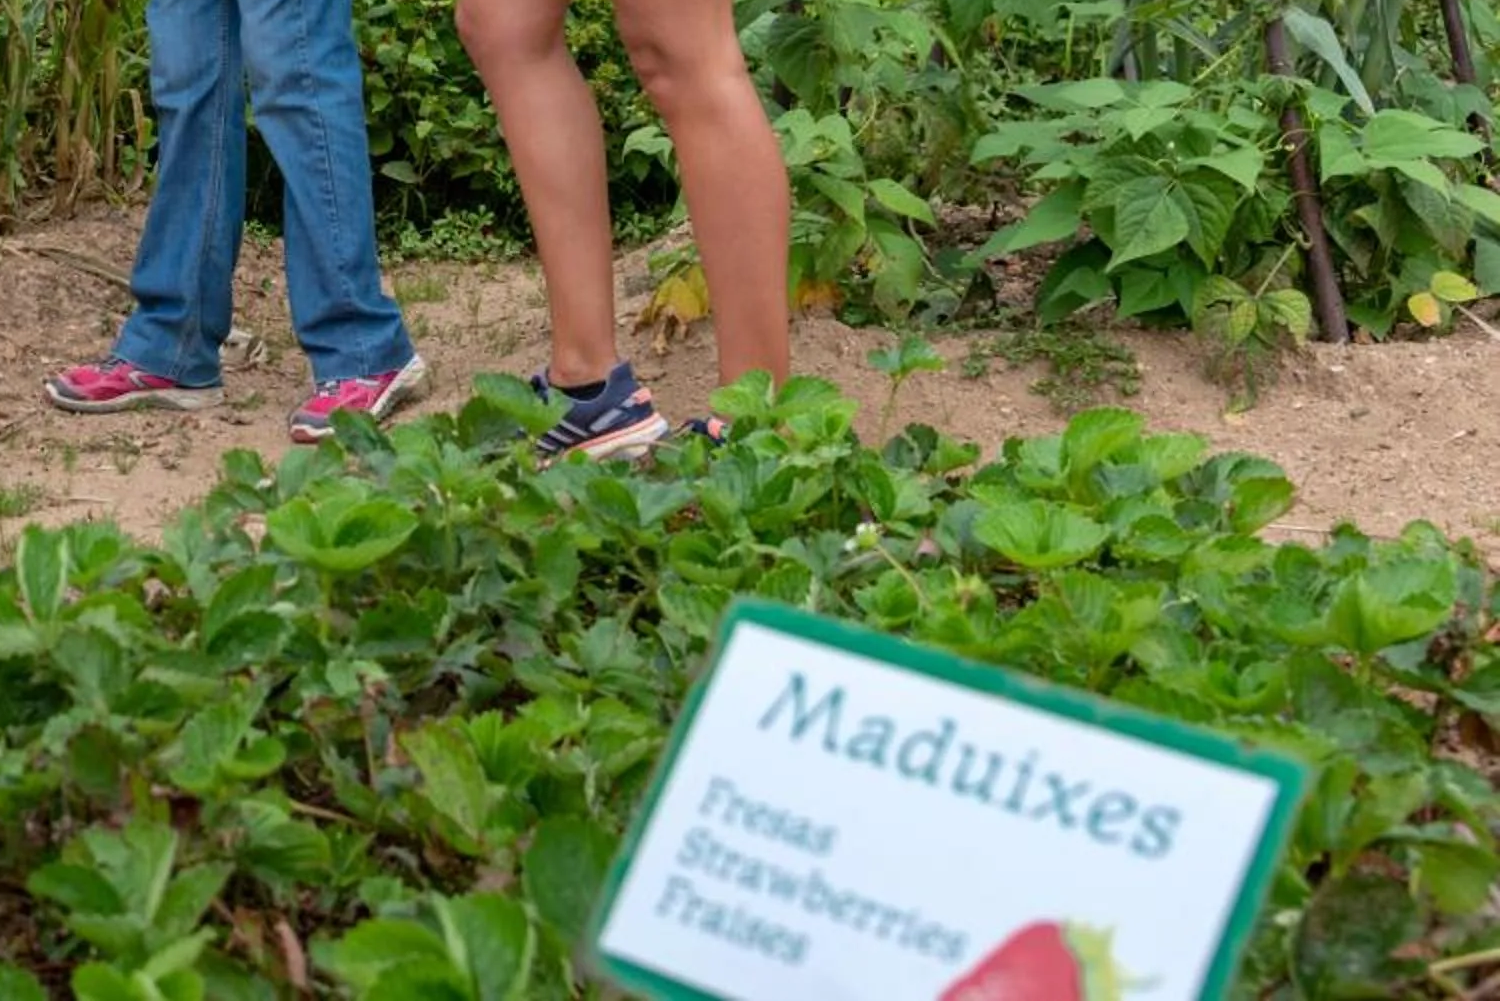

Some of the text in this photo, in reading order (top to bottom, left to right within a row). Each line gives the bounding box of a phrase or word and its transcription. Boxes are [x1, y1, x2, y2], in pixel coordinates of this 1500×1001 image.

[698, 776, 838, 857] Fresas
[758, 671, 1183, 861] Maduixes
[655, 876, 811, 964] Fraises
[675, 828, 970, 963] Strawberries
